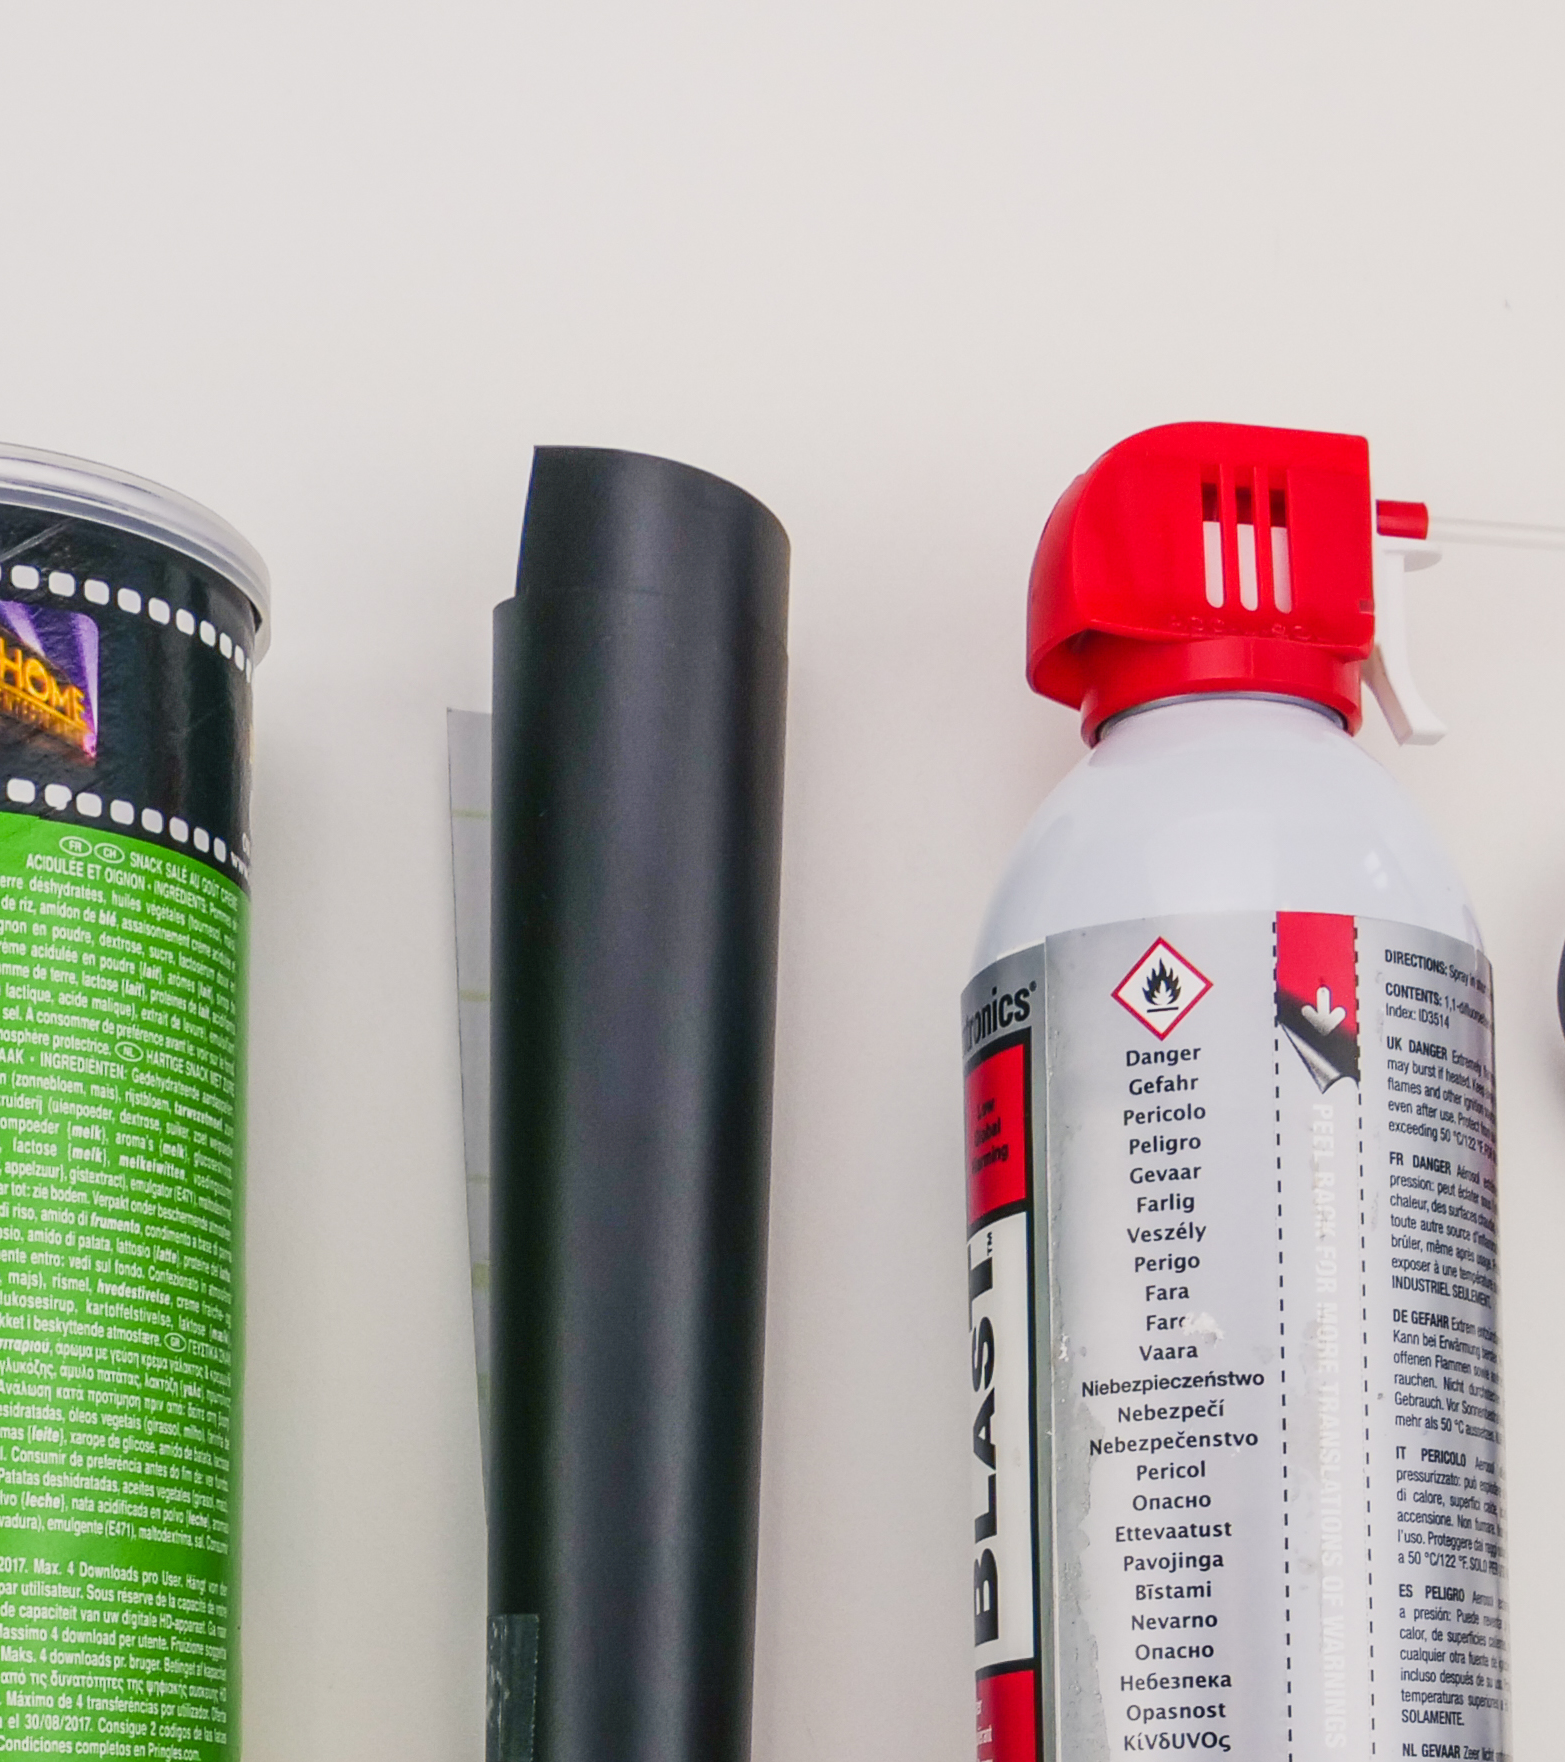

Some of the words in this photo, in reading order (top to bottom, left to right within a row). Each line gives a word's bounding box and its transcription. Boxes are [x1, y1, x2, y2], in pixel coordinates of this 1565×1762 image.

[1384, 949, 1449, 977] DIRECTIONS:
[1385, 981, 1443, 1006] CONTENTS:
[1385, 1003, 1417, 1021] Index:
[1418, 1008, 1450, 1029] ID3514
[1125, 1045, 1202, 1069] Danger
[1386, 1035, 1403, 1051] UK
[1408, 1039, 1448, 1060] DANGER
[1128, 1073, 1200, 1096] Gefahr
[1122, 1103, 1207, 1127] Pericolo
[1128, 1133, 1202, 1157] Peligro
[1312, 1103, 1336, 1163] PEEL
[1129, 1163, 1202, 1185] Gevaar
[1136, 1193, 1196, 1217] Farlig
[1313, 1170, 1337, 1239] BACK
[1126, 1222, 1207, 1247] Veszély
[1134, 1252, 1201, 1276] Perigo
[1315, 1243, 1338, 1294] FOR
[1145, 1284, 1190, 1302] Fara
[1411, 1309, 1450, 1330] GEFAHR
[1317, 1301, 1340, 1374] MORE
[1138, 1344, 1199, 1362] Vaara
[1081, 1370, 1265, 1398] Niebezpieczeństwo
[1117, 1399, 1225, 1424] Nebezpečí
[967, 1243, 1000, 1648] BLAST
[1089, 1430, 1259, 1456] Nebezpečenstvo
[1420, 1447, 1467, 1467] PERICOLO
[1136, 1460, 1207, 1482] Pericol
[1319, 1382, 1344, 1567] TRANSLATIONS
[1132, 1491, 1212, 1512] Опасно
[1114, 1520, 1233, 1544] Ettevaatust
[1122, 1551, 1225, 1576] Pavojinga
[1135, 1581, 1212, 1601] Bīstami
[1323, 1574, 1345, 1607] OF
[1425, 1584, 1465, 1602] PELIGRO
[1131, 1614, 1218, 1631] Nevarno
[1135, 1644, 1214, 1661] Опасно
[1120, 1673, 1233, 1691] Небезпека
[1323, 1614, 1347, 1750] WARNINGS
[1126, 1703, 1227, 1725] Opasnost
[1401, 1708, 1465, 1726] SOLAMENTE.
[1421, 1743, 1461, 1759] GEVAAR
